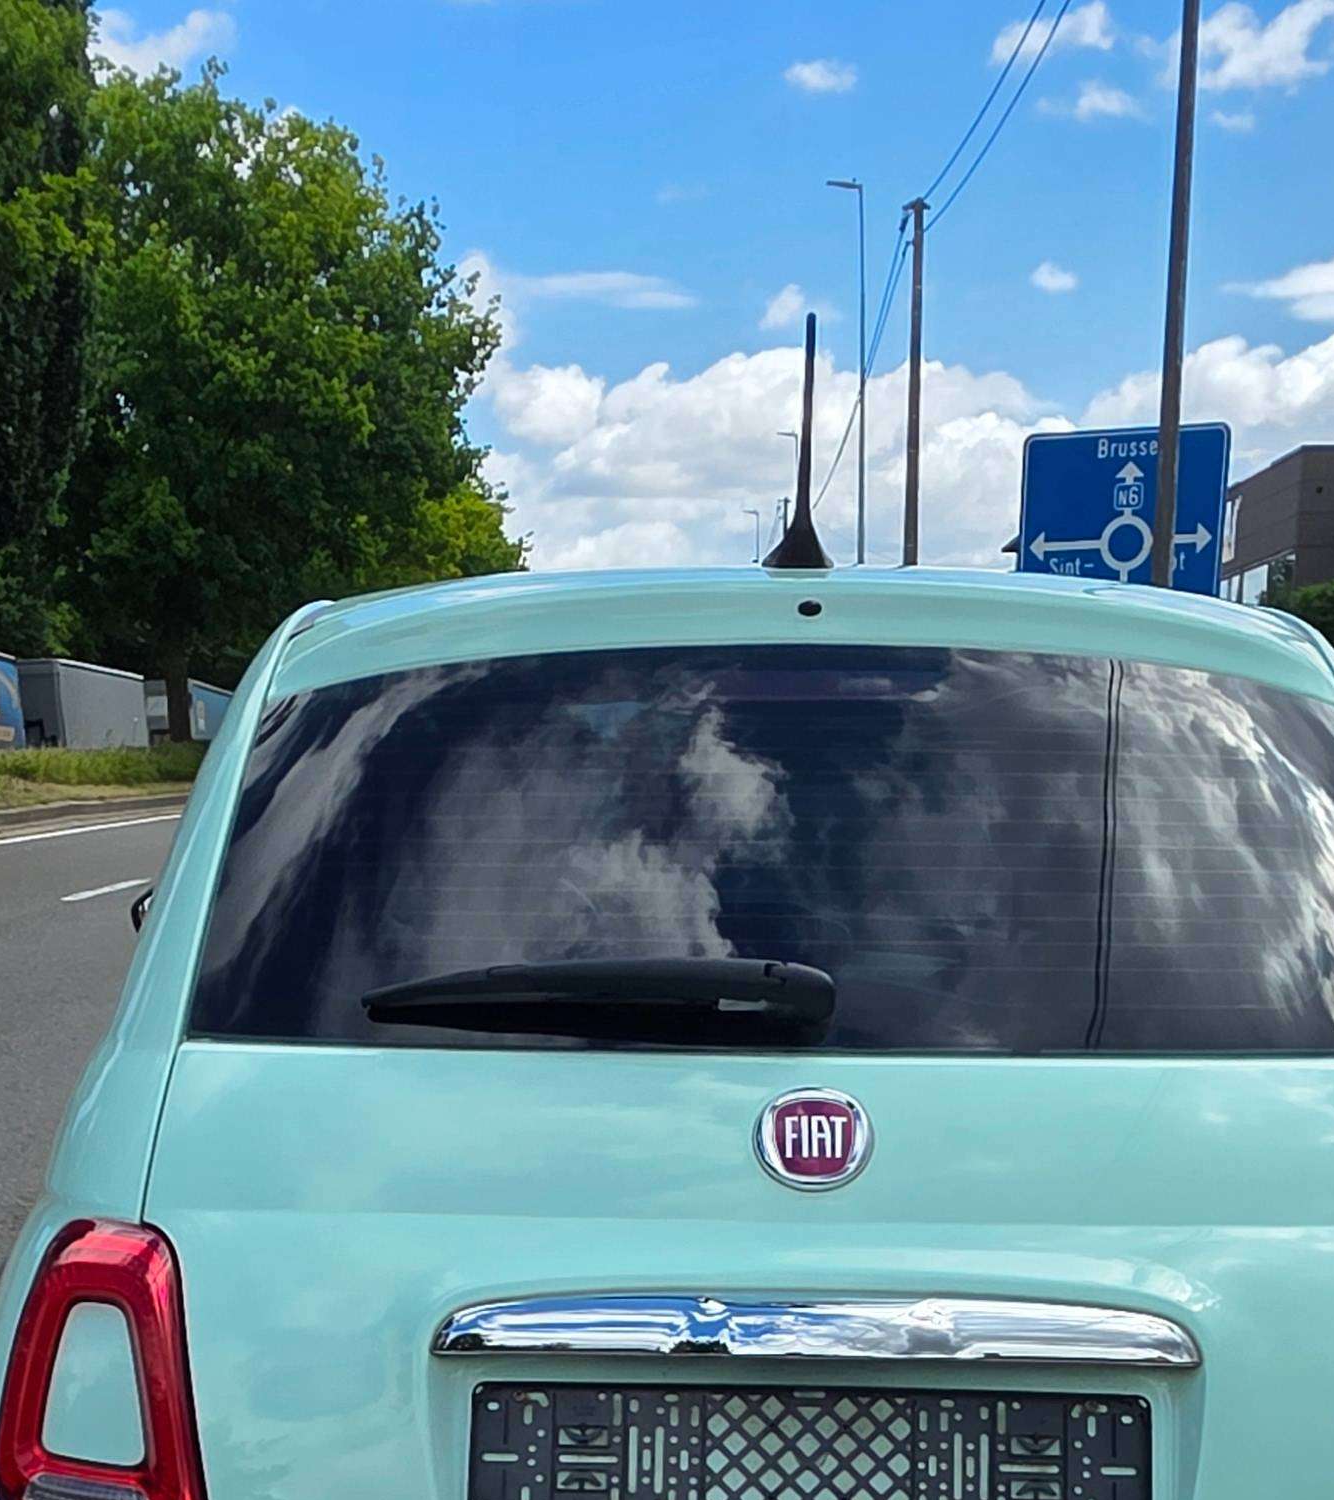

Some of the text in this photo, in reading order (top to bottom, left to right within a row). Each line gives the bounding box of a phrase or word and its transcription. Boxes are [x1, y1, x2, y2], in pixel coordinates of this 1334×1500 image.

[1098, 438, 1158, 459] Brusse
[1118, 486, 1139, 506] N6
[1049, 557, 1095, 576] Sint-
[784, 1114, 848, 1159] FIAT
